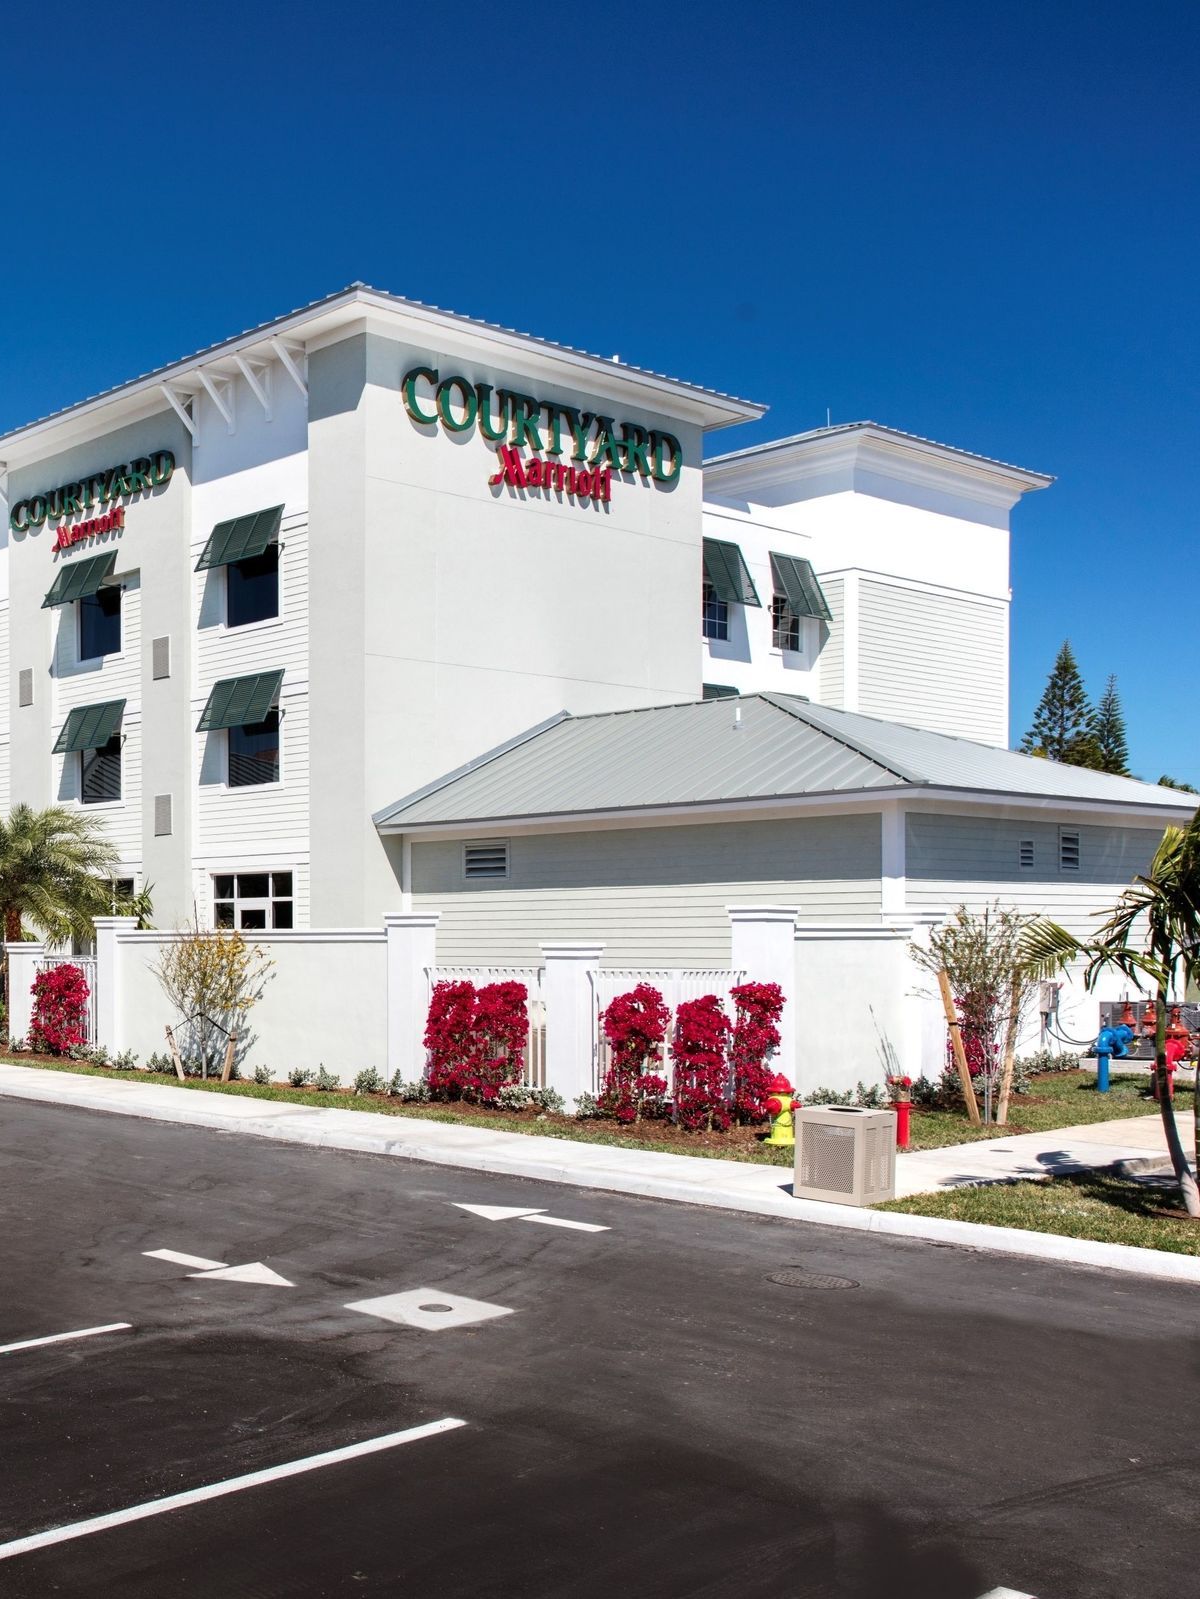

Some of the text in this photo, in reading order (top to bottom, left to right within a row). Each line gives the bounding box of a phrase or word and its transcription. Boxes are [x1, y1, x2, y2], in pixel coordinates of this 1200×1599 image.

[401, 367, 683, 482] COURTYARD
[10, 450, 176, 533] COURTYARD
[488, 444, 611, 502] Marriott
[51, 505, 126, 553] Marriott
